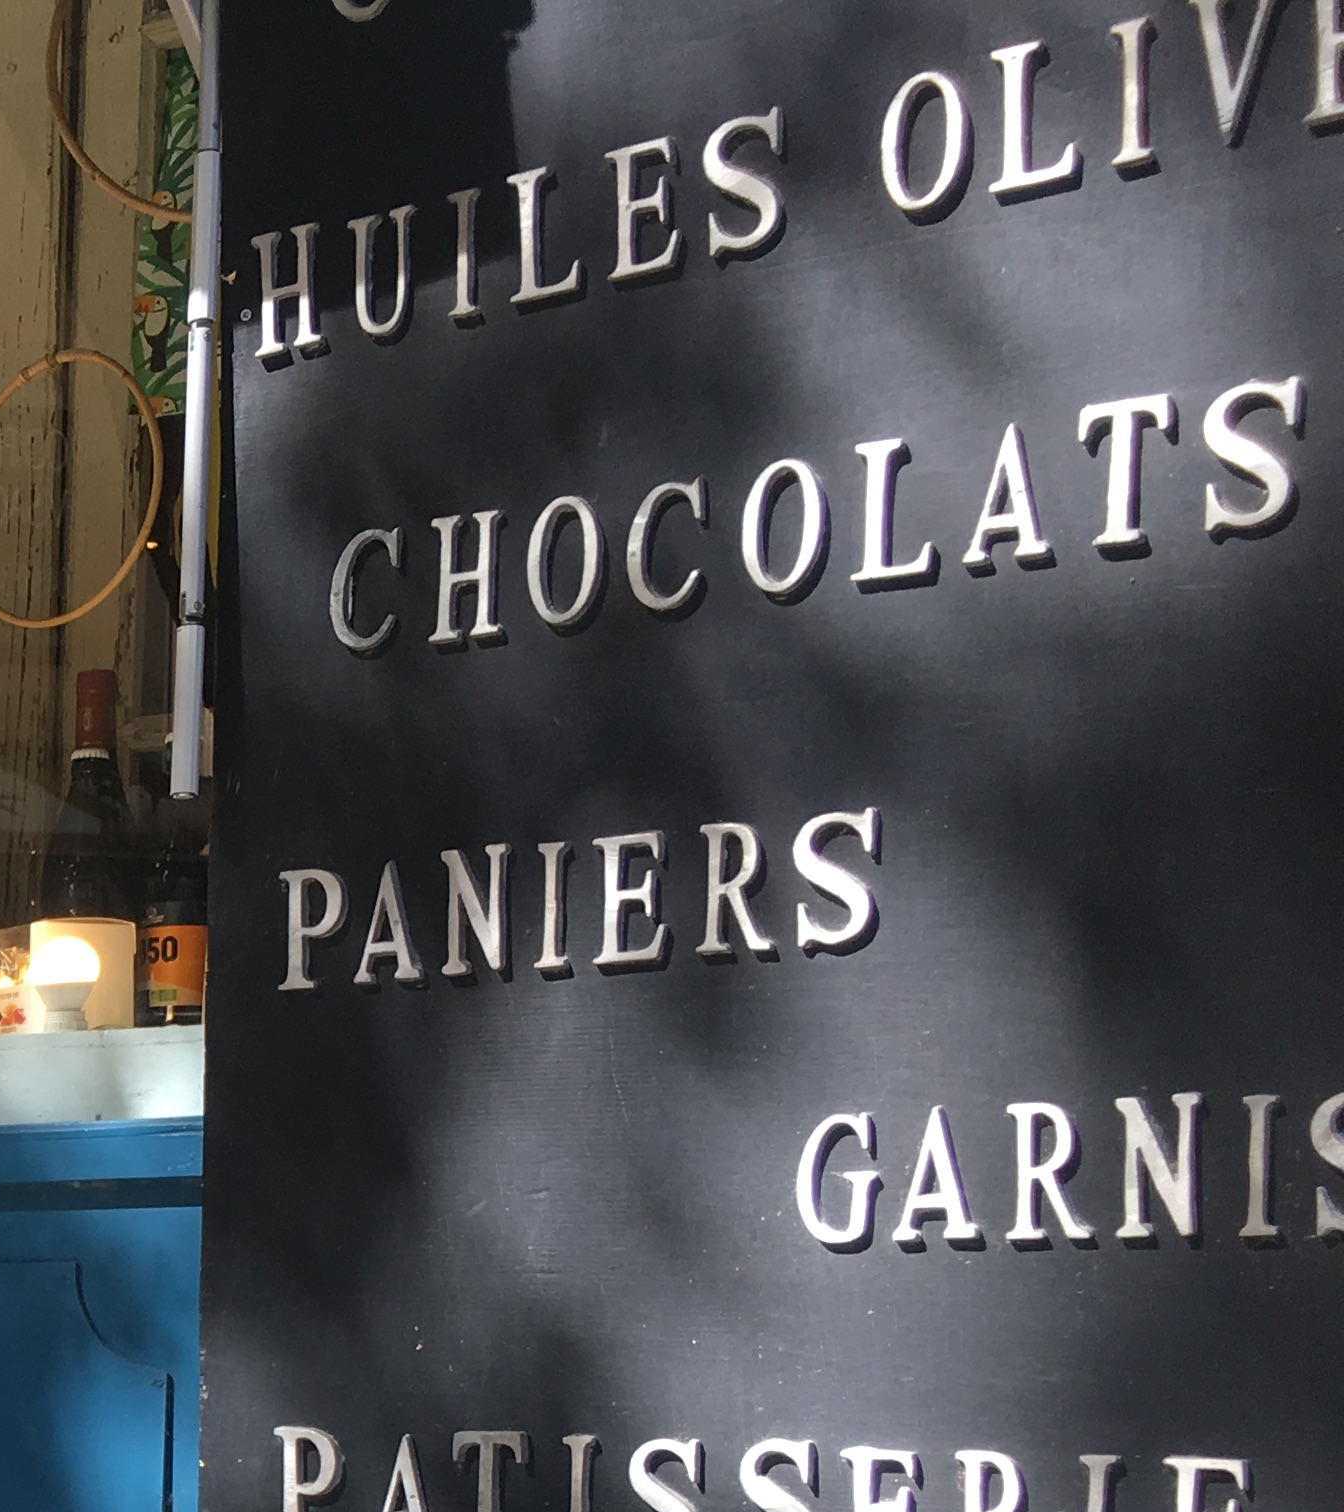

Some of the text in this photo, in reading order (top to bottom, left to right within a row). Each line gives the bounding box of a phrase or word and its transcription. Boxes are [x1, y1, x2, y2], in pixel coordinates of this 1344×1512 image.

[250, 105, 787, 362] HUILES
[328, 374, 1307, 654] CHOCOLATS
[277, 807, 882, 992] PANIERS
